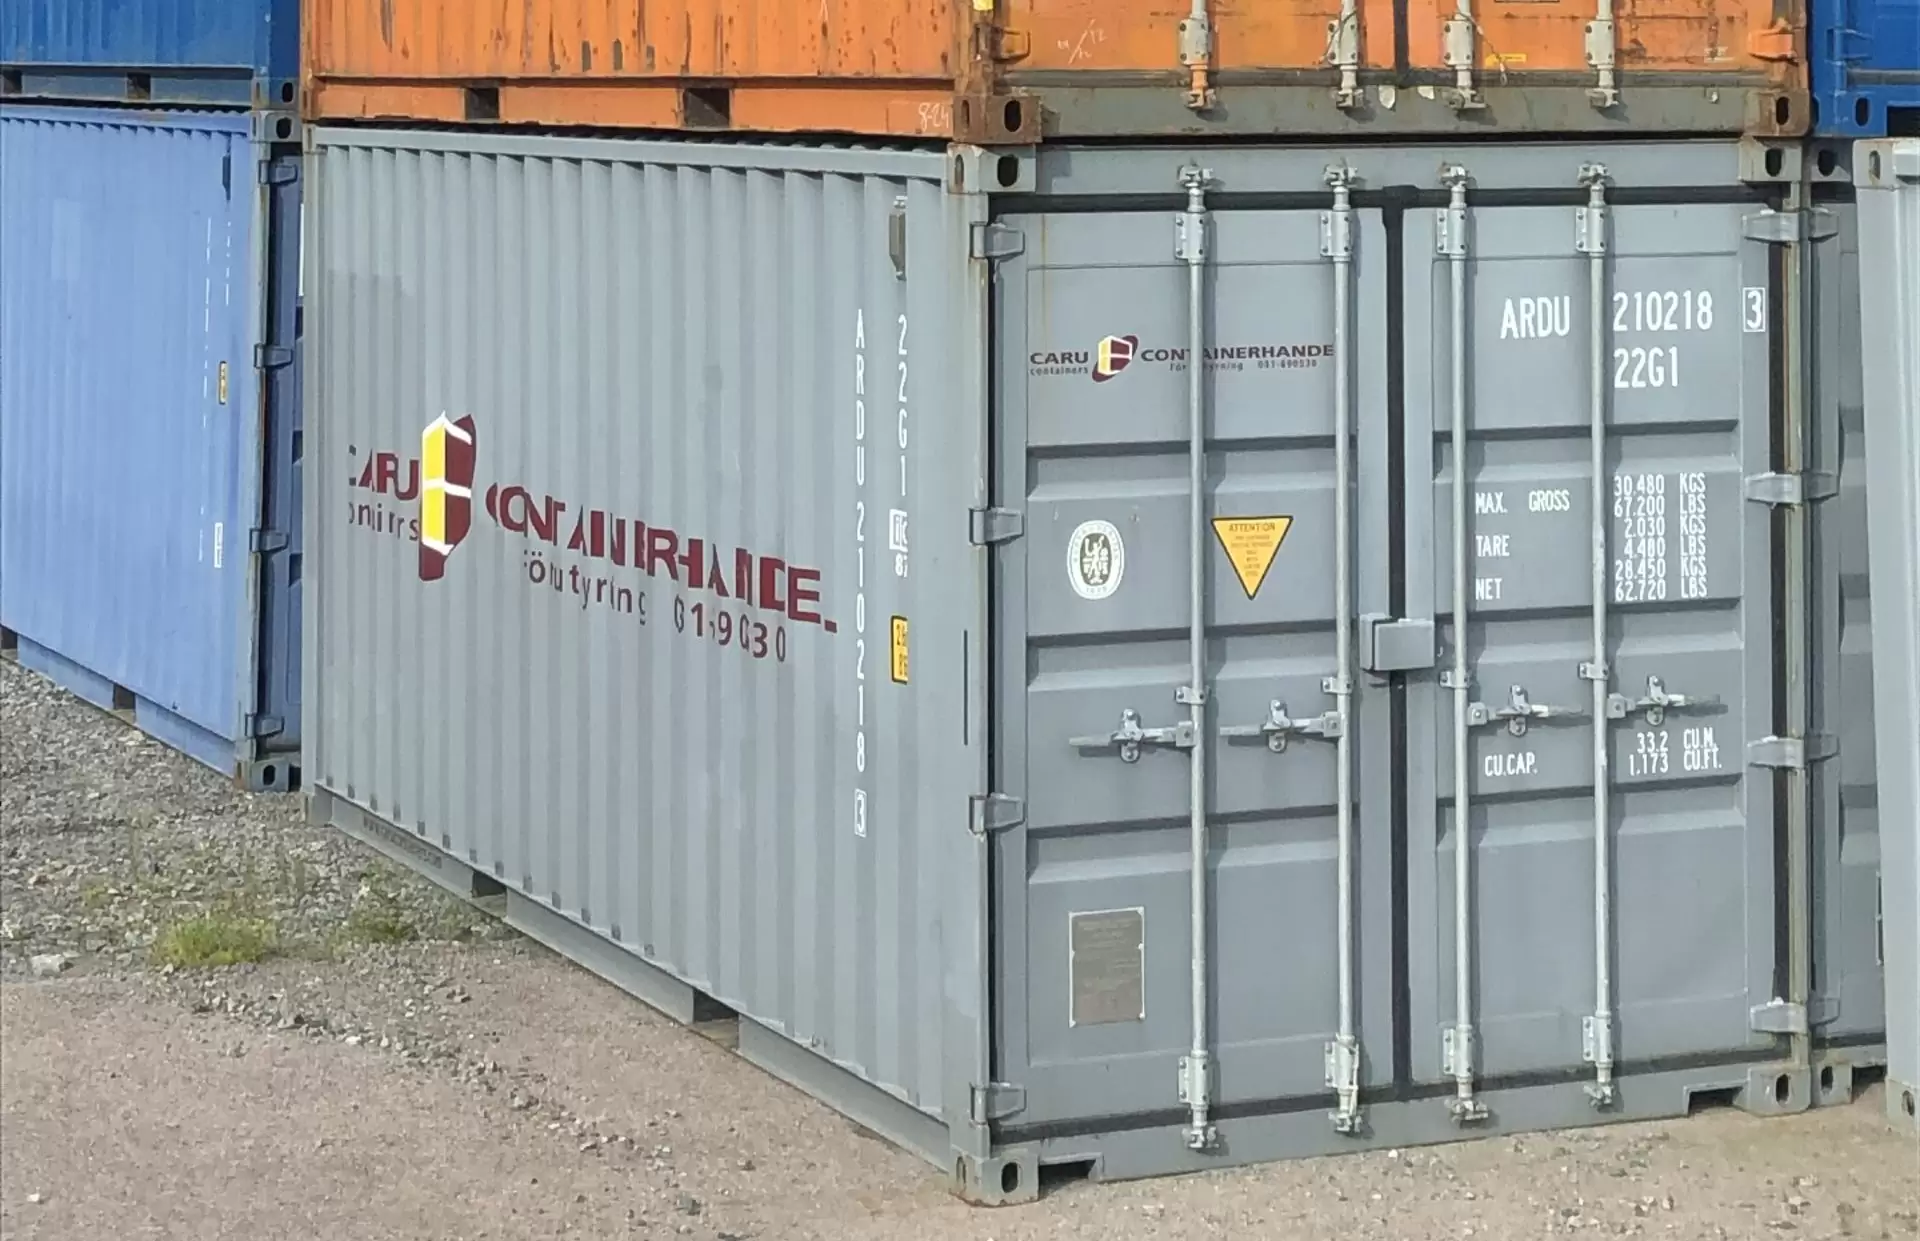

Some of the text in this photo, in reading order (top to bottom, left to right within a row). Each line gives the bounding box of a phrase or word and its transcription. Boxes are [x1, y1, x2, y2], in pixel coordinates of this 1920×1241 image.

[1500, 289, 1763, 339] ARDU 210218 3
[1030, 344, 1334, 364] CARU CONAINERHANDE
[1614, 346, 1678, 388] 22G1
[898, 314, 907, 496] 22G1
[1614, 472, 1706, 496] 30.480 KGS
[1475, 489, 1570, 514] MAX. GROSS
[1614, 493, 1706, 518] 67.200 LBS
[1229, 522, 1276, 532] ATTENTON
[1624, 514, 1706, 538] 2.030 KGS
[1475, 535, 1510, 557] TARE
[1624, 535, 1706, 560] 4.480 LBS
[856, 308, 866, 834] ARDU 210218 3
[1615, 555, 1707, 581] 28.450 KGS
[1475, 578, 1502, 600] NET
[1615, 577, 1708, 602] 62.720 LBS
[1636, 731, 1669, 753] 33.2
[1484, 752, 1538, 777] CU.CAP.
[1628, 753, 1669, 777] 1.173
